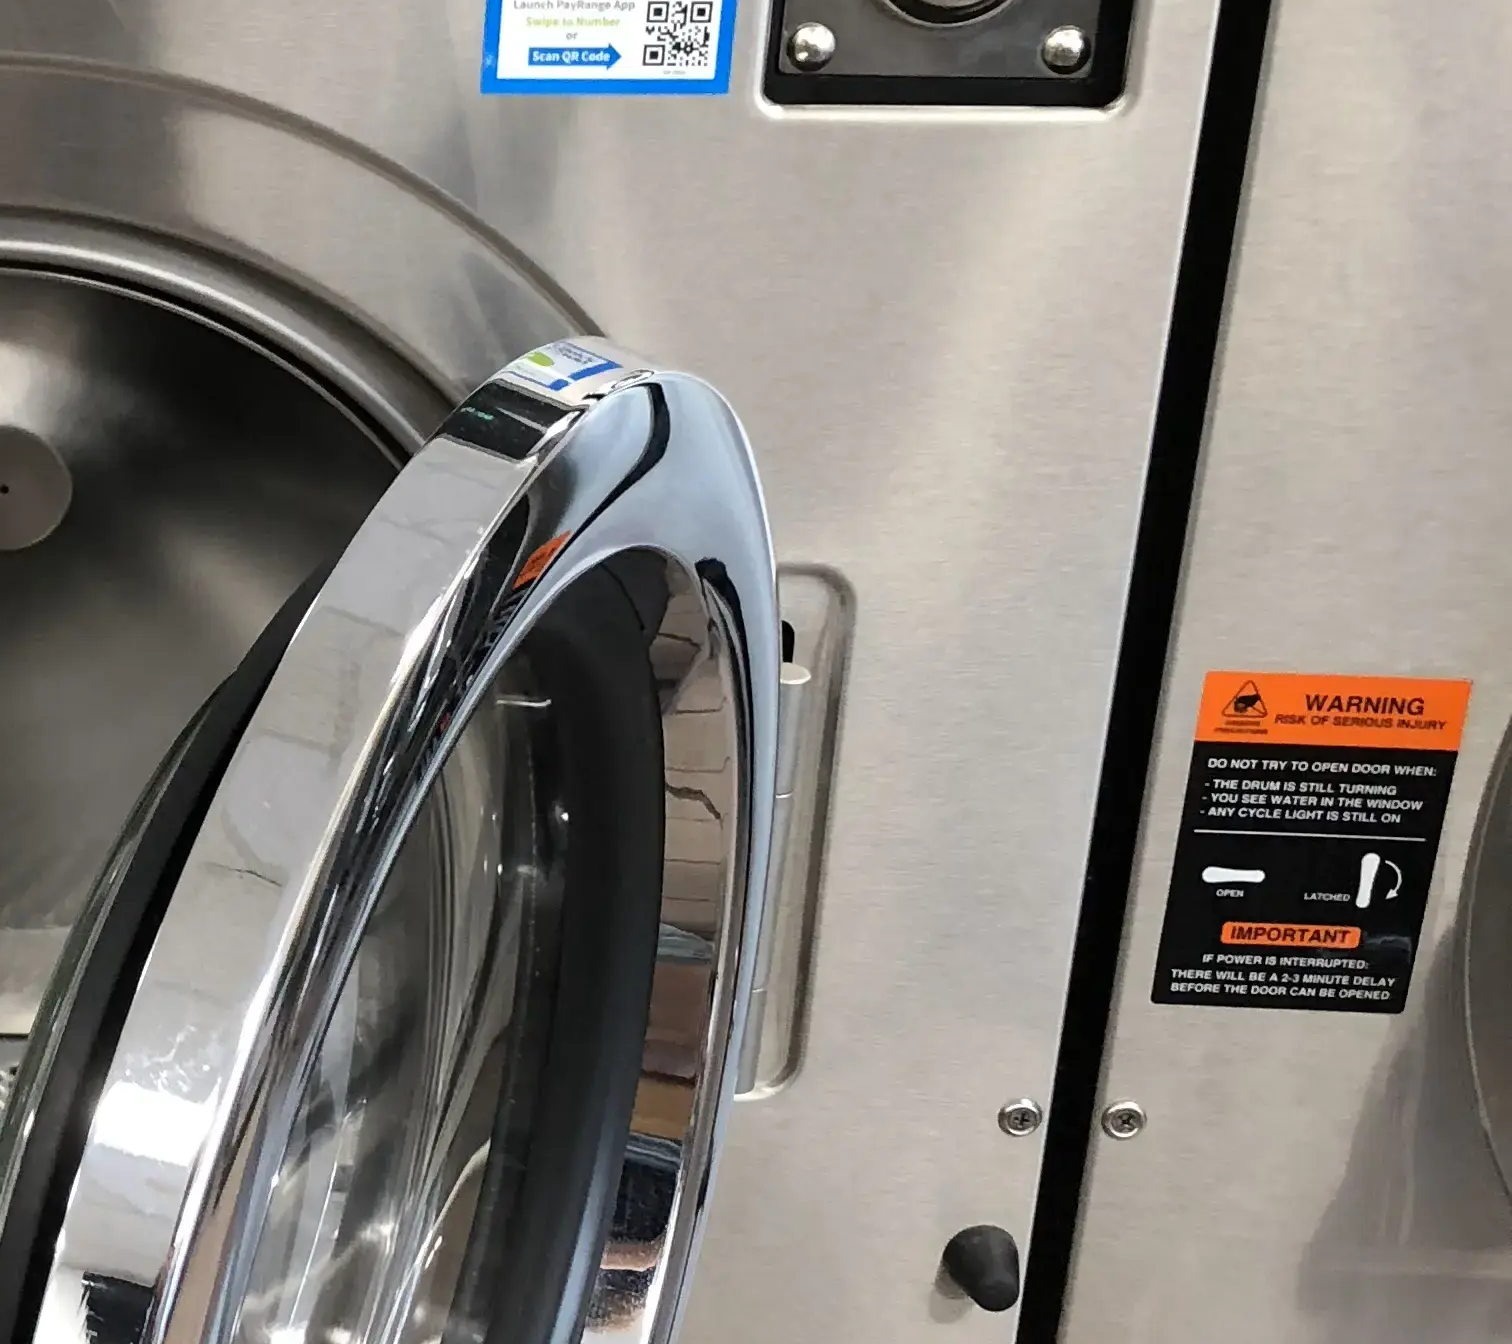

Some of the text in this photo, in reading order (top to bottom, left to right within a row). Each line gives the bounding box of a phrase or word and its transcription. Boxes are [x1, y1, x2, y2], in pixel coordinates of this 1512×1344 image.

[514, 0, 635, 12] Launch PayRange App
[526, 17, 621, 28] Swipe to Number
[566, 32, 578, 40] or
[533, 51, 610, 63] Scan QR Code
[1306, 694, 1425, 716] WARNING
[1274, 714, 1447, 731] RISK OF SERIOUS INJURY
[1213, 779, 1396, 796] THE DRUM IS STILL TURNING
[1211, 793, 1423, 811] YOU SEE WATER IN THE WINDOW
[1216, 889, 1244, 898] OPEN
[1304, 892, 1350, 902] LATCHED
[1231, 925, 1351, 944] IMPORTANT
